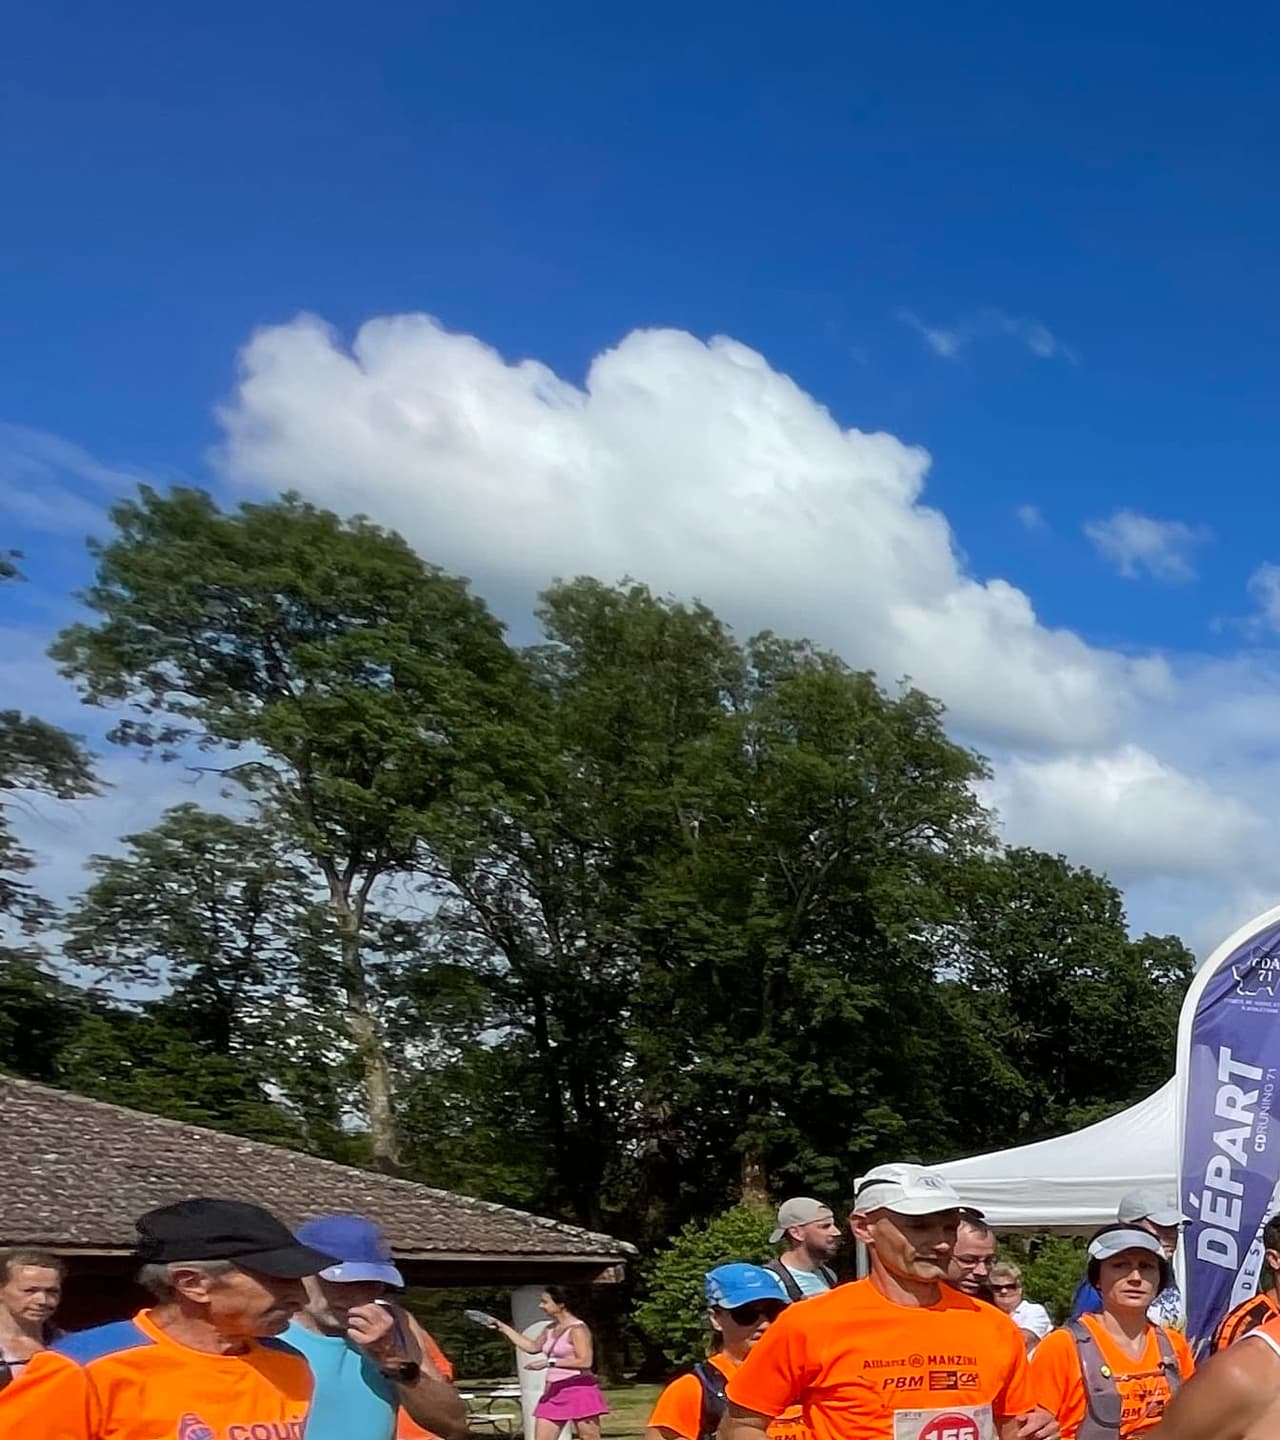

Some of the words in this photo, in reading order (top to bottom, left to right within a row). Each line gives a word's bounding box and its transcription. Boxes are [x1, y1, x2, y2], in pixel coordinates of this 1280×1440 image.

[1258, 970, 1273, 981] 71
[1188, 1046, 1264, 1271] DÉPART
[863, 1359, 906, 1369] Allianz
[882, 1375, 924, 1391] PBM
